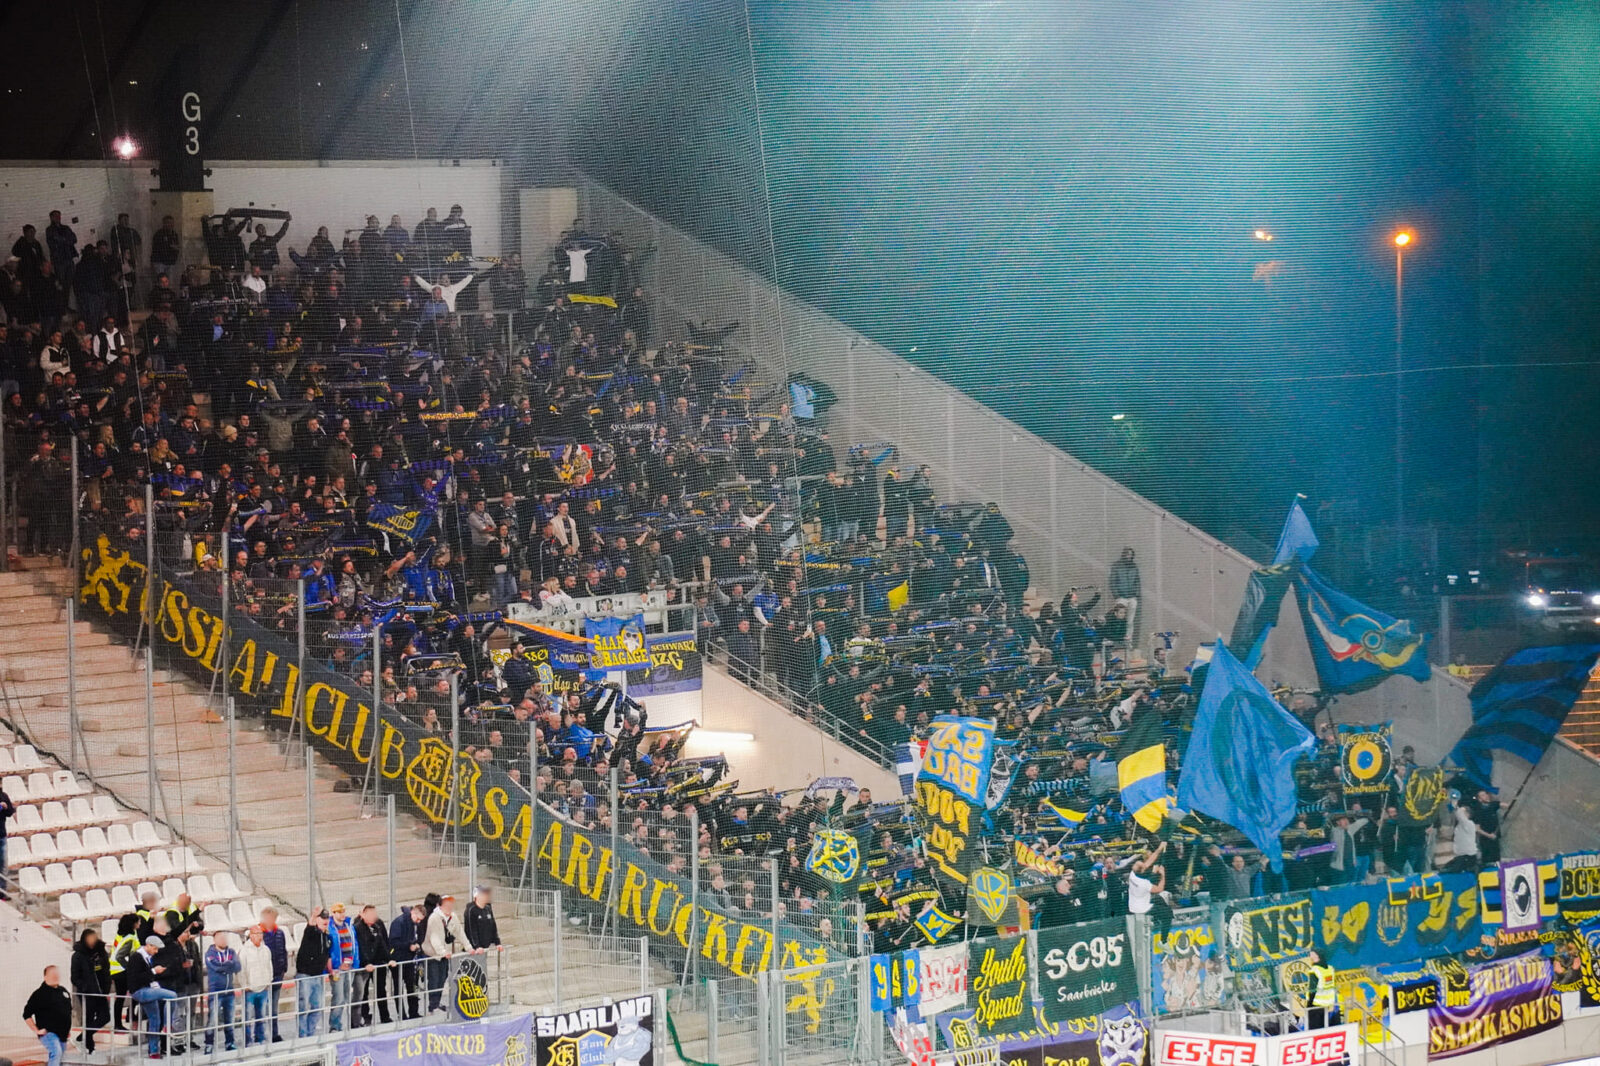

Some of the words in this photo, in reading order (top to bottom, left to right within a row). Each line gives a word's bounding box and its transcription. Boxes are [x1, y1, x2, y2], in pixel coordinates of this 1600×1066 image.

[182, 92, 201, 121] G
[186, 126, 200, 155] 3
[594, 634, 625, 651] SAAR
[650, 640, 698, 653] SCHWARZ
[602, 648, 649, 667] BAGAGE
[974, 937, 1026, 991] Youth
[1043, 933, 1124, 979] SC95
[537, 996, 652, 1037] SAARLAND
[976, 981, 1026, 1030] Squad
[1429, 994, 1562, 1054] SAARKASMUS
[398, 1033, 423, 1059] FCS
[427, 1032, 486, 1056] FANCLUB
